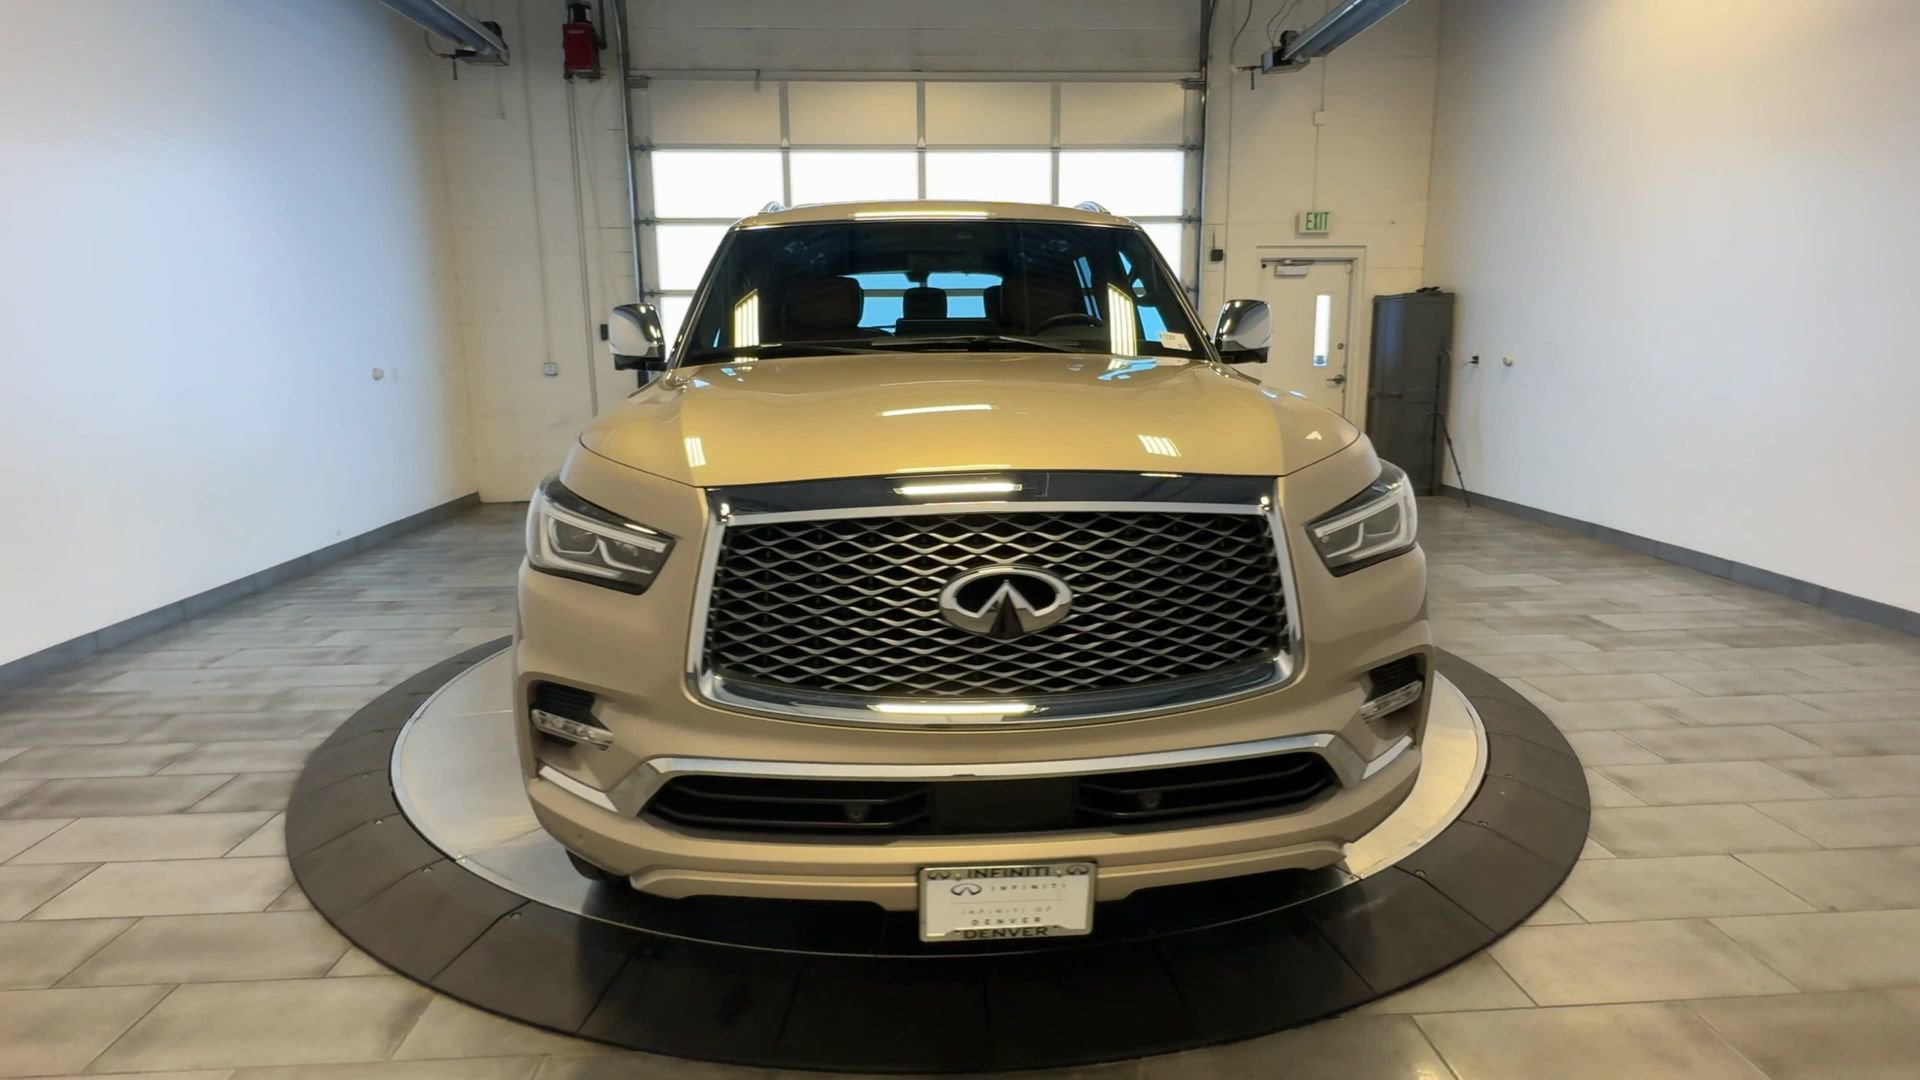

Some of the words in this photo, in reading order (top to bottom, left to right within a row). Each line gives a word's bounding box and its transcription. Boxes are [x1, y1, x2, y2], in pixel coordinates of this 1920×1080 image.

[1306, 212, 1329, 231] EXIT
[967, 866, 1050, 879] INFINITI
[962, 926, 1049, 939] DENVER
